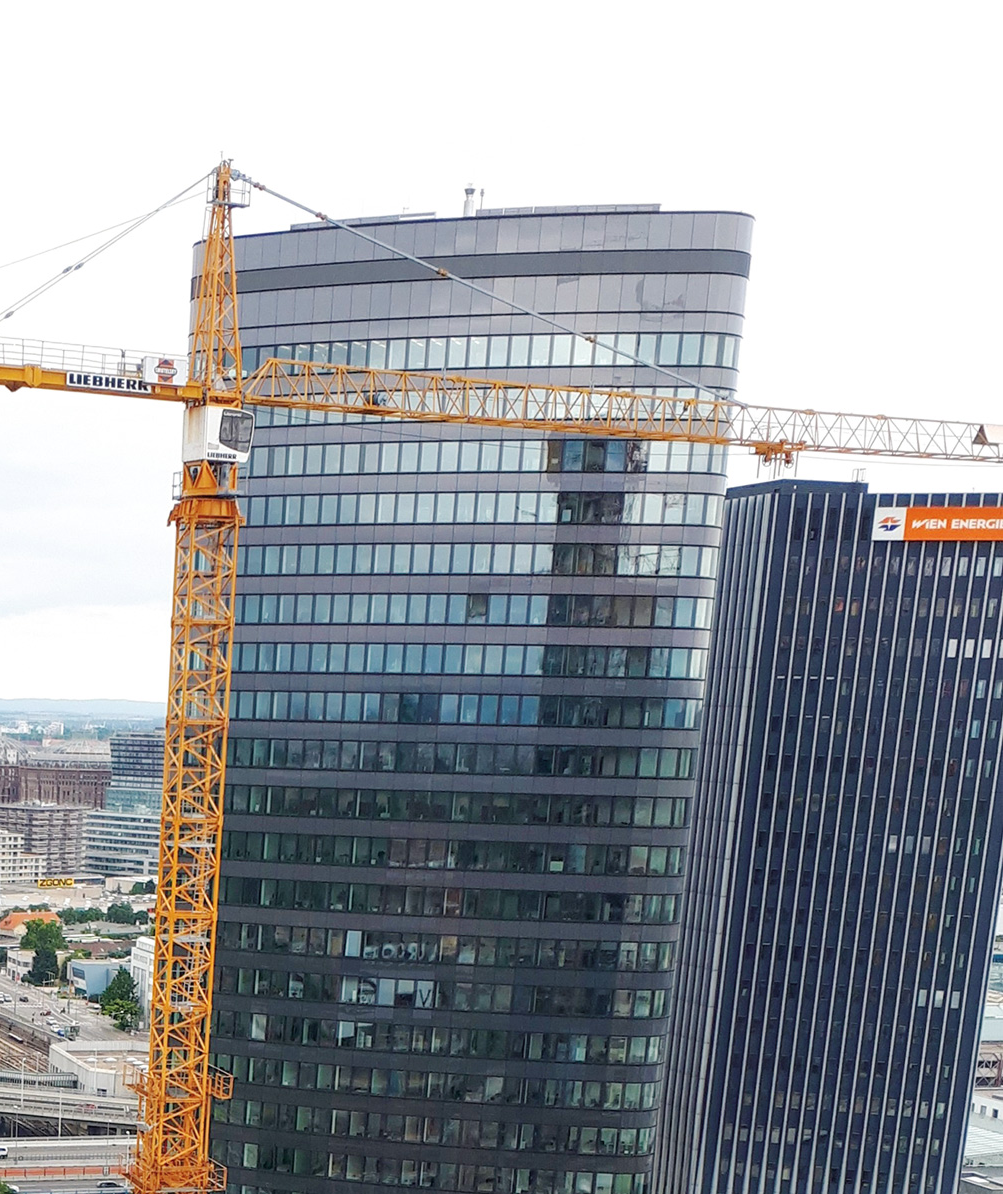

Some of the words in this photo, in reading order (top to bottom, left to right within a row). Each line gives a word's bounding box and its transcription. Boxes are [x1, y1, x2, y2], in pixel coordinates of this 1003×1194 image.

[69, 373, 149, 392] LIEBHERR
[207, 452, 237, 460] LIEBHERR
[912, 518, 947, 529] WIEN
